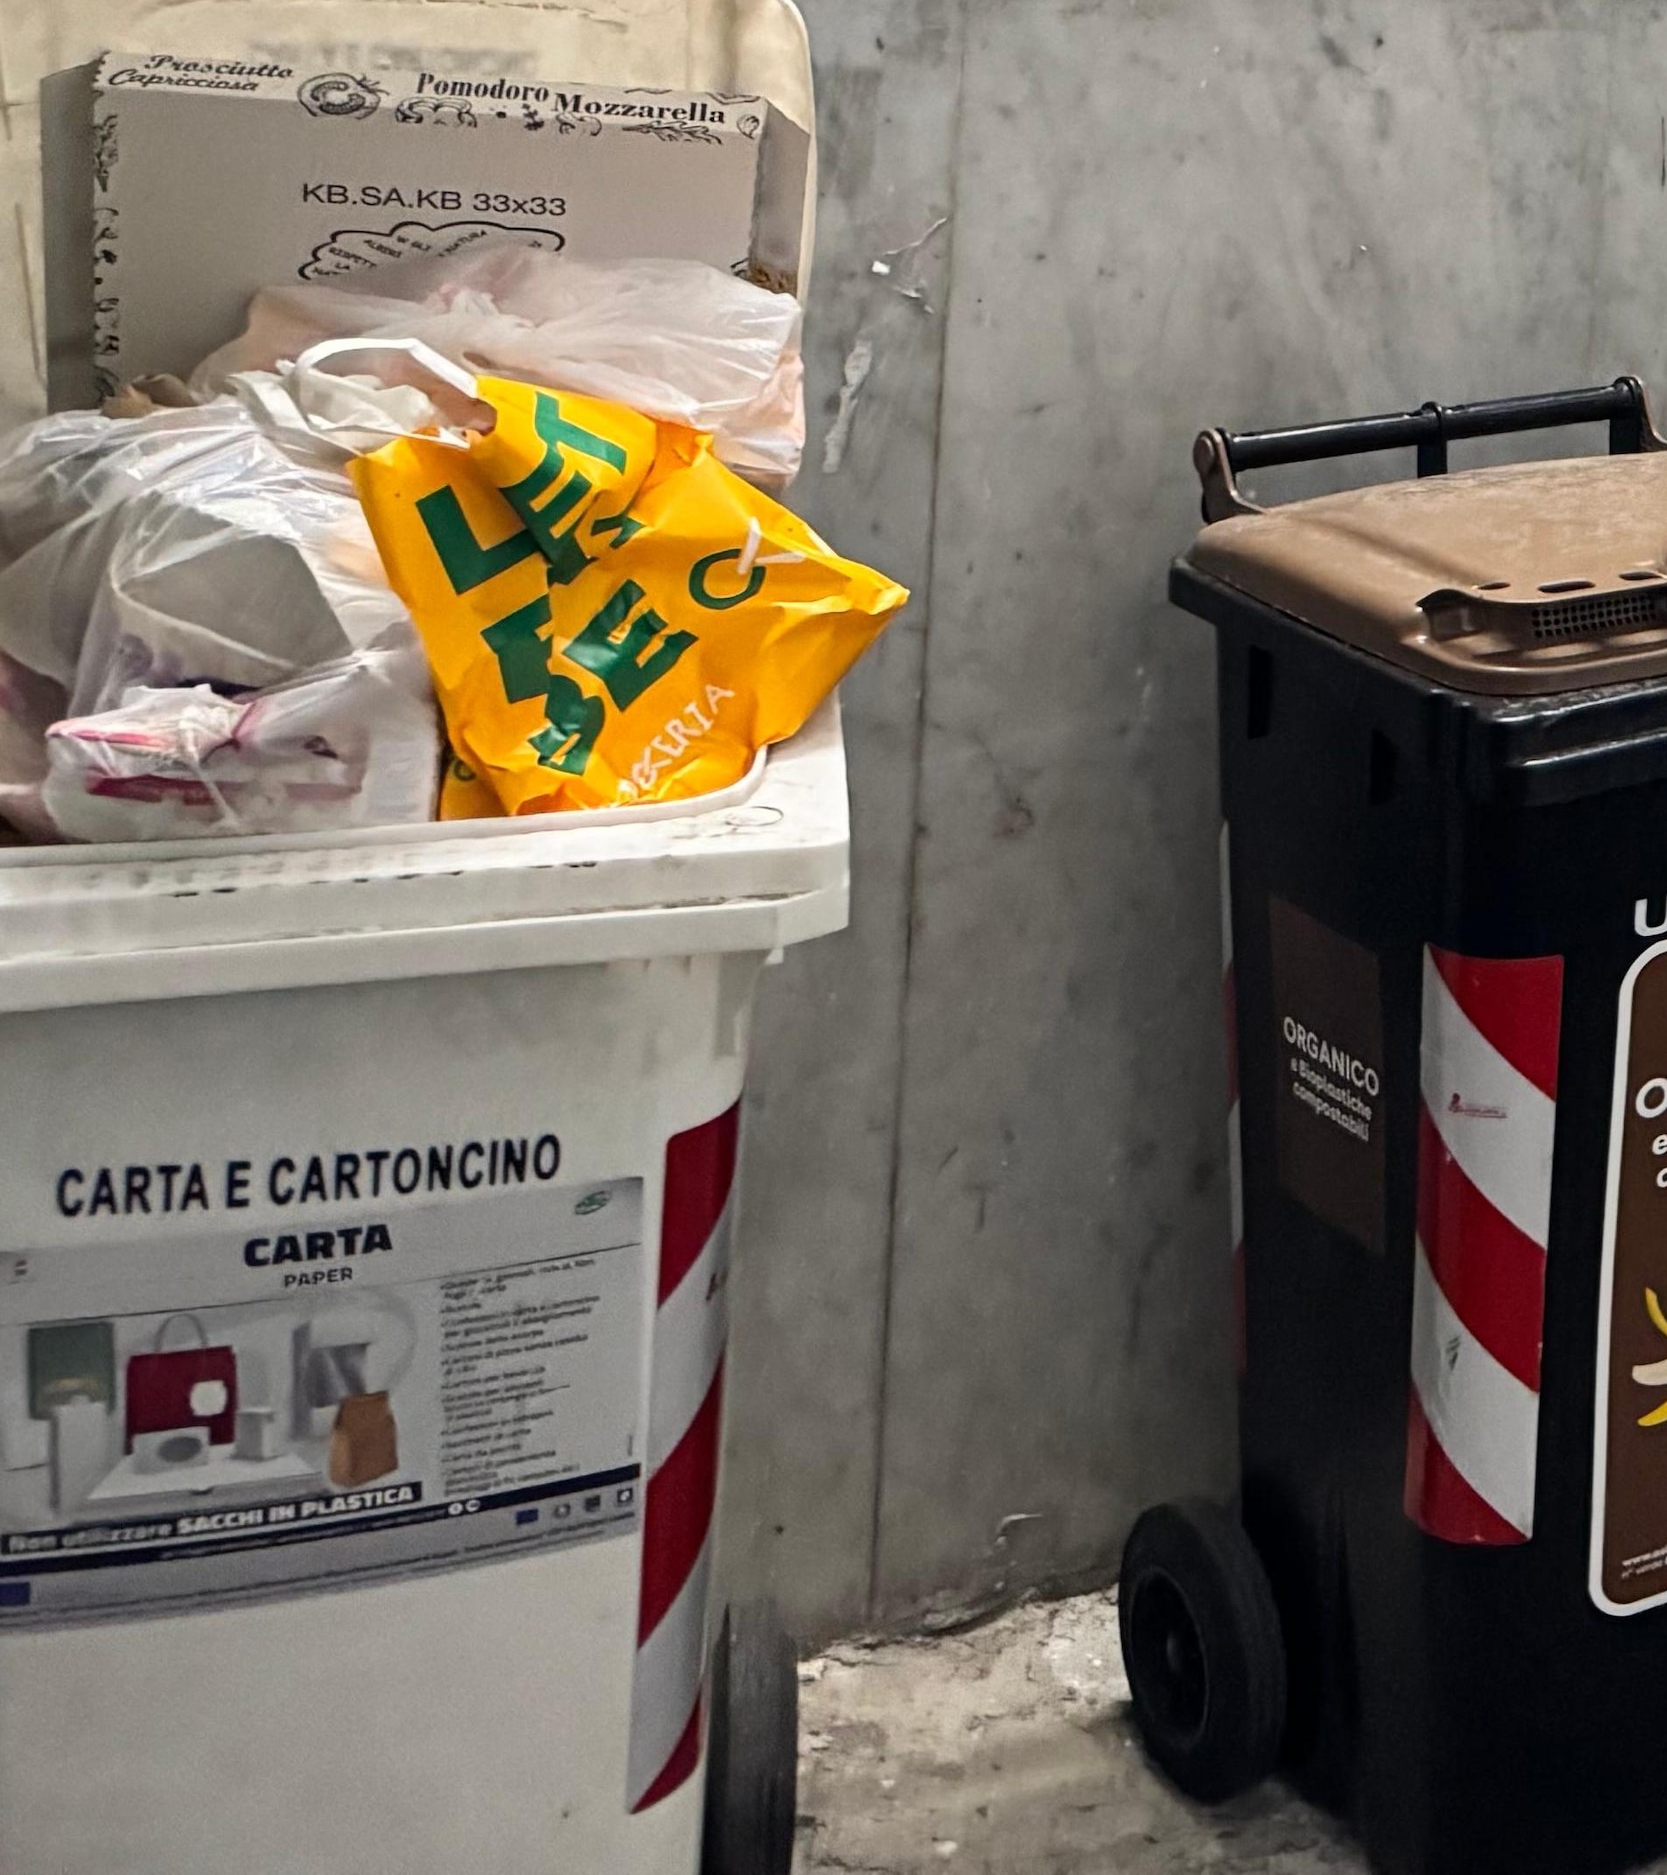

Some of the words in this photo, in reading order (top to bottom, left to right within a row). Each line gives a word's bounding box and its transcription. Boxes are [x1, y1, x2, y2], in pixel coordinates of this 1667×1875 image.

[108, 68, 261, 92] Capricciosa
[145, 54, 294, 79] Prosciutto
[417, 72, 549, 102] Pomodoro
[551, 92, 726, 124] Mozzarella
[302, 183, 462, 210] KB.SA.KB
[473, 193, 566, 216] 33x33
[1283, 1016, 1379, 1096] ORGANICO
[57, 1163, 209, 1217] CARTA
[226, 1160, 252, 1208] E
[268, 1133, 562, 1205] CARTONCINO
[244, 1223, 393, 1267] CARTA
[284, 1267, 353, 1288] PAPER
[176, 1507, 263, 1536] SACCHI
[301, 1485, 415, 1518] PLASTICA
